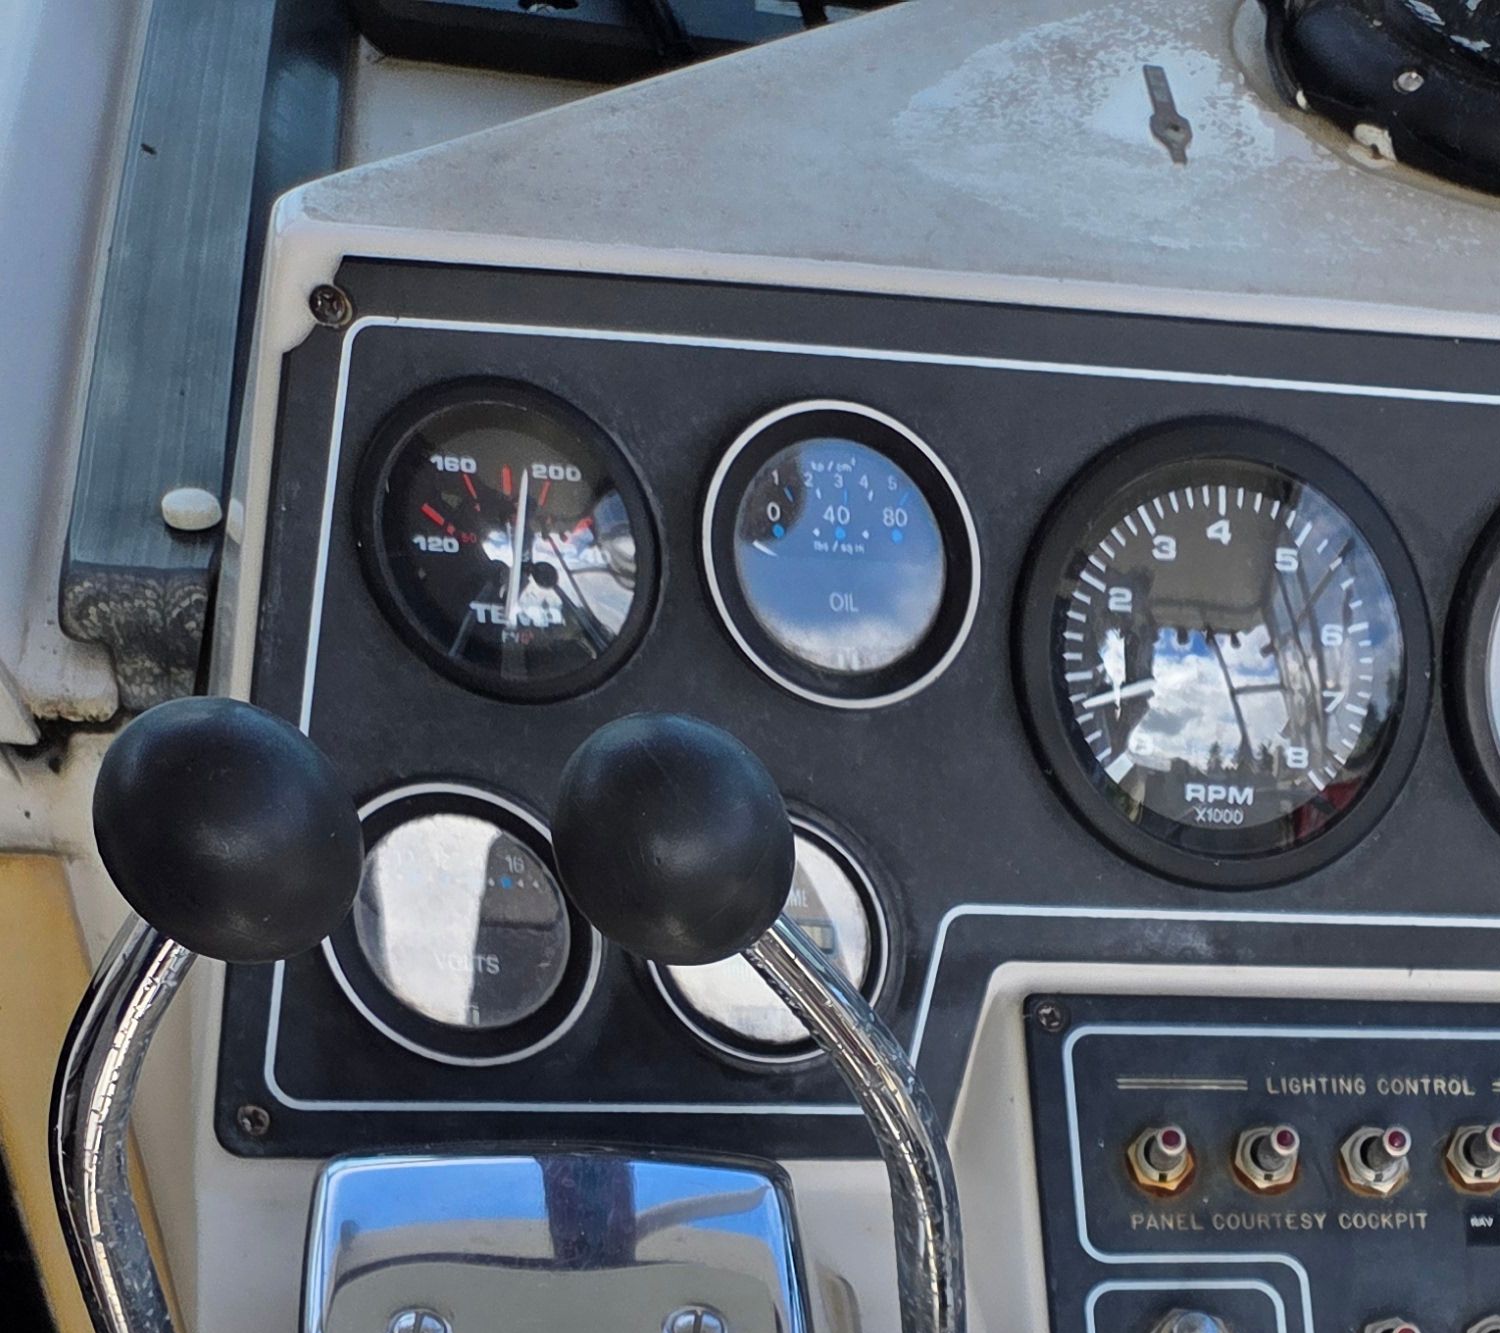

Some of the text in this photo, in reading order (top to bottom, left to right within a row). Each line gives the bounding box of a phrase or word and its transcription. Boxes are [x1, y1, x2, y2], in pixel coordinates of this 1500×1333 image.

[430, 455, 477, 474] 160
[532, 463, 582, 482] 200
[767, 502, 781, 522] 0
[823, 505, 850, 525] 40
[882, 507, 909, 527] 80
[1206, 519, 1232, 546] 4
[413, 534, 460, 553] 120
[1152, 535, 1177, 561] 3
[1275, 548, 1299, 573] 5
[829, 592, 859, 613] OIL
[1108, 586, 1133, 613] 2
[1320, 623, 1344, 647] 6
[1322, 691, 1346, 713] 7
[1285, 746, 1309, 769] 8
[1185, 782, 1254, 805] RPM
[1193, 806, 1244, 826] X1000
[1266, 1076, 1476, 1096] LIGHTING CONTROL
[1131, 1211, 1428, 1230] PANEL COURTESY COCKPIT
[1470, 1216, 1494, 1229] NAV
